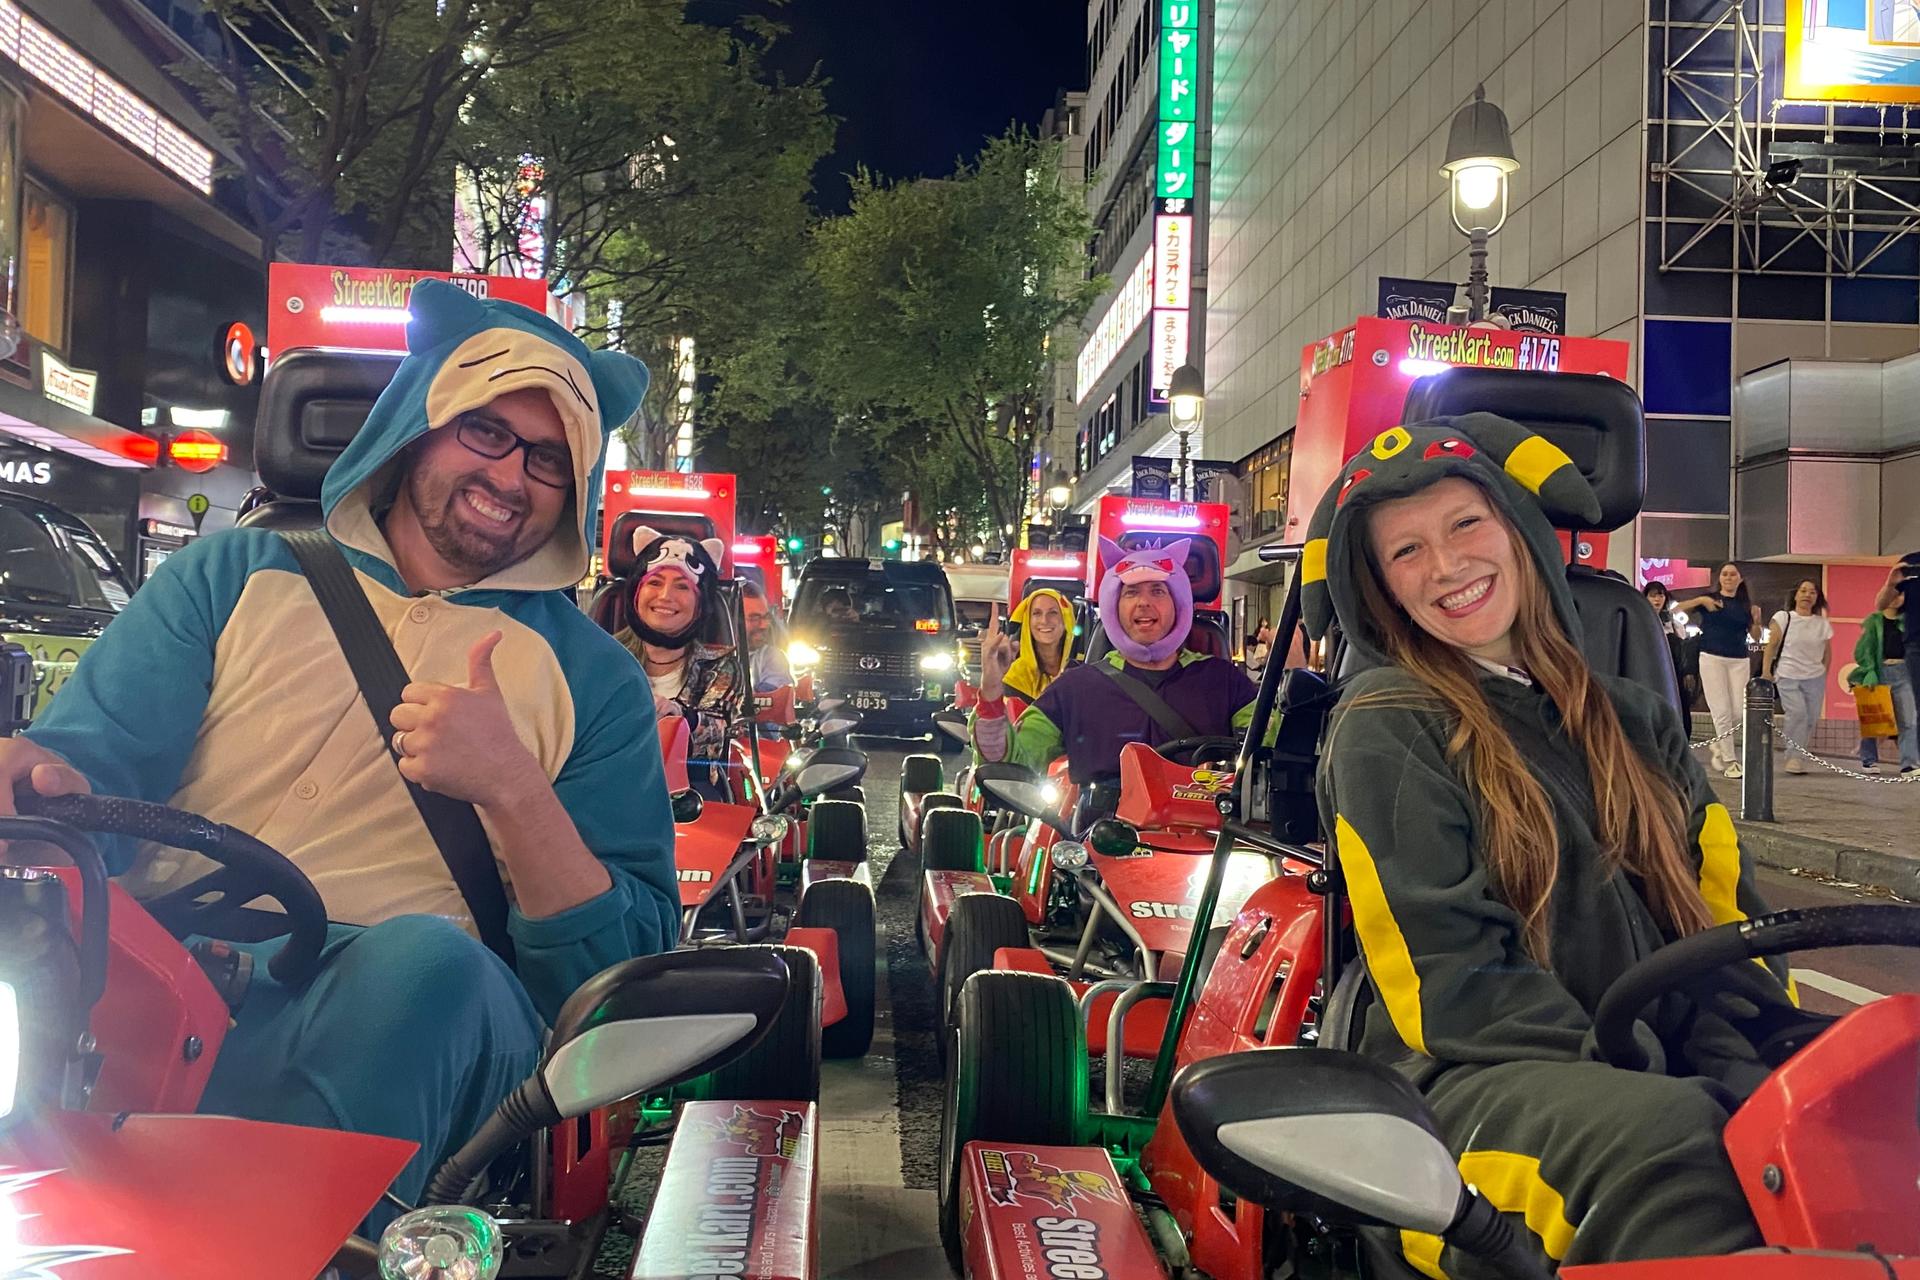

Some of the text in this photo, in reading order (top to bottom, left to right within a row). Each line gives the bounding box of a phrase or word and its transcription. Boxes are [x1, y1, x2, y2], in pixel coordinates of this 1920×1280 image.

[1164, 0, 1192, 193] リヤード・ダーツ
[1164, 198, 1185, 214] 3F
[1164, 234, 1181, 291] カラオケ
[1386, 303, 1410, 320] JACK
[1508, 309, 1558, 335] CK DANIEL'S
[1407, 323, 1560, 373] StreetKart.com #176
[0, 460, 51, 485] MAS
[856, 697, 887, 710] 80-39
[1131, 901, 1197, 921] Stre
[1012, 1222, 1027, 1239] Best
[1016, 1239, 1037, 1273] Activities
